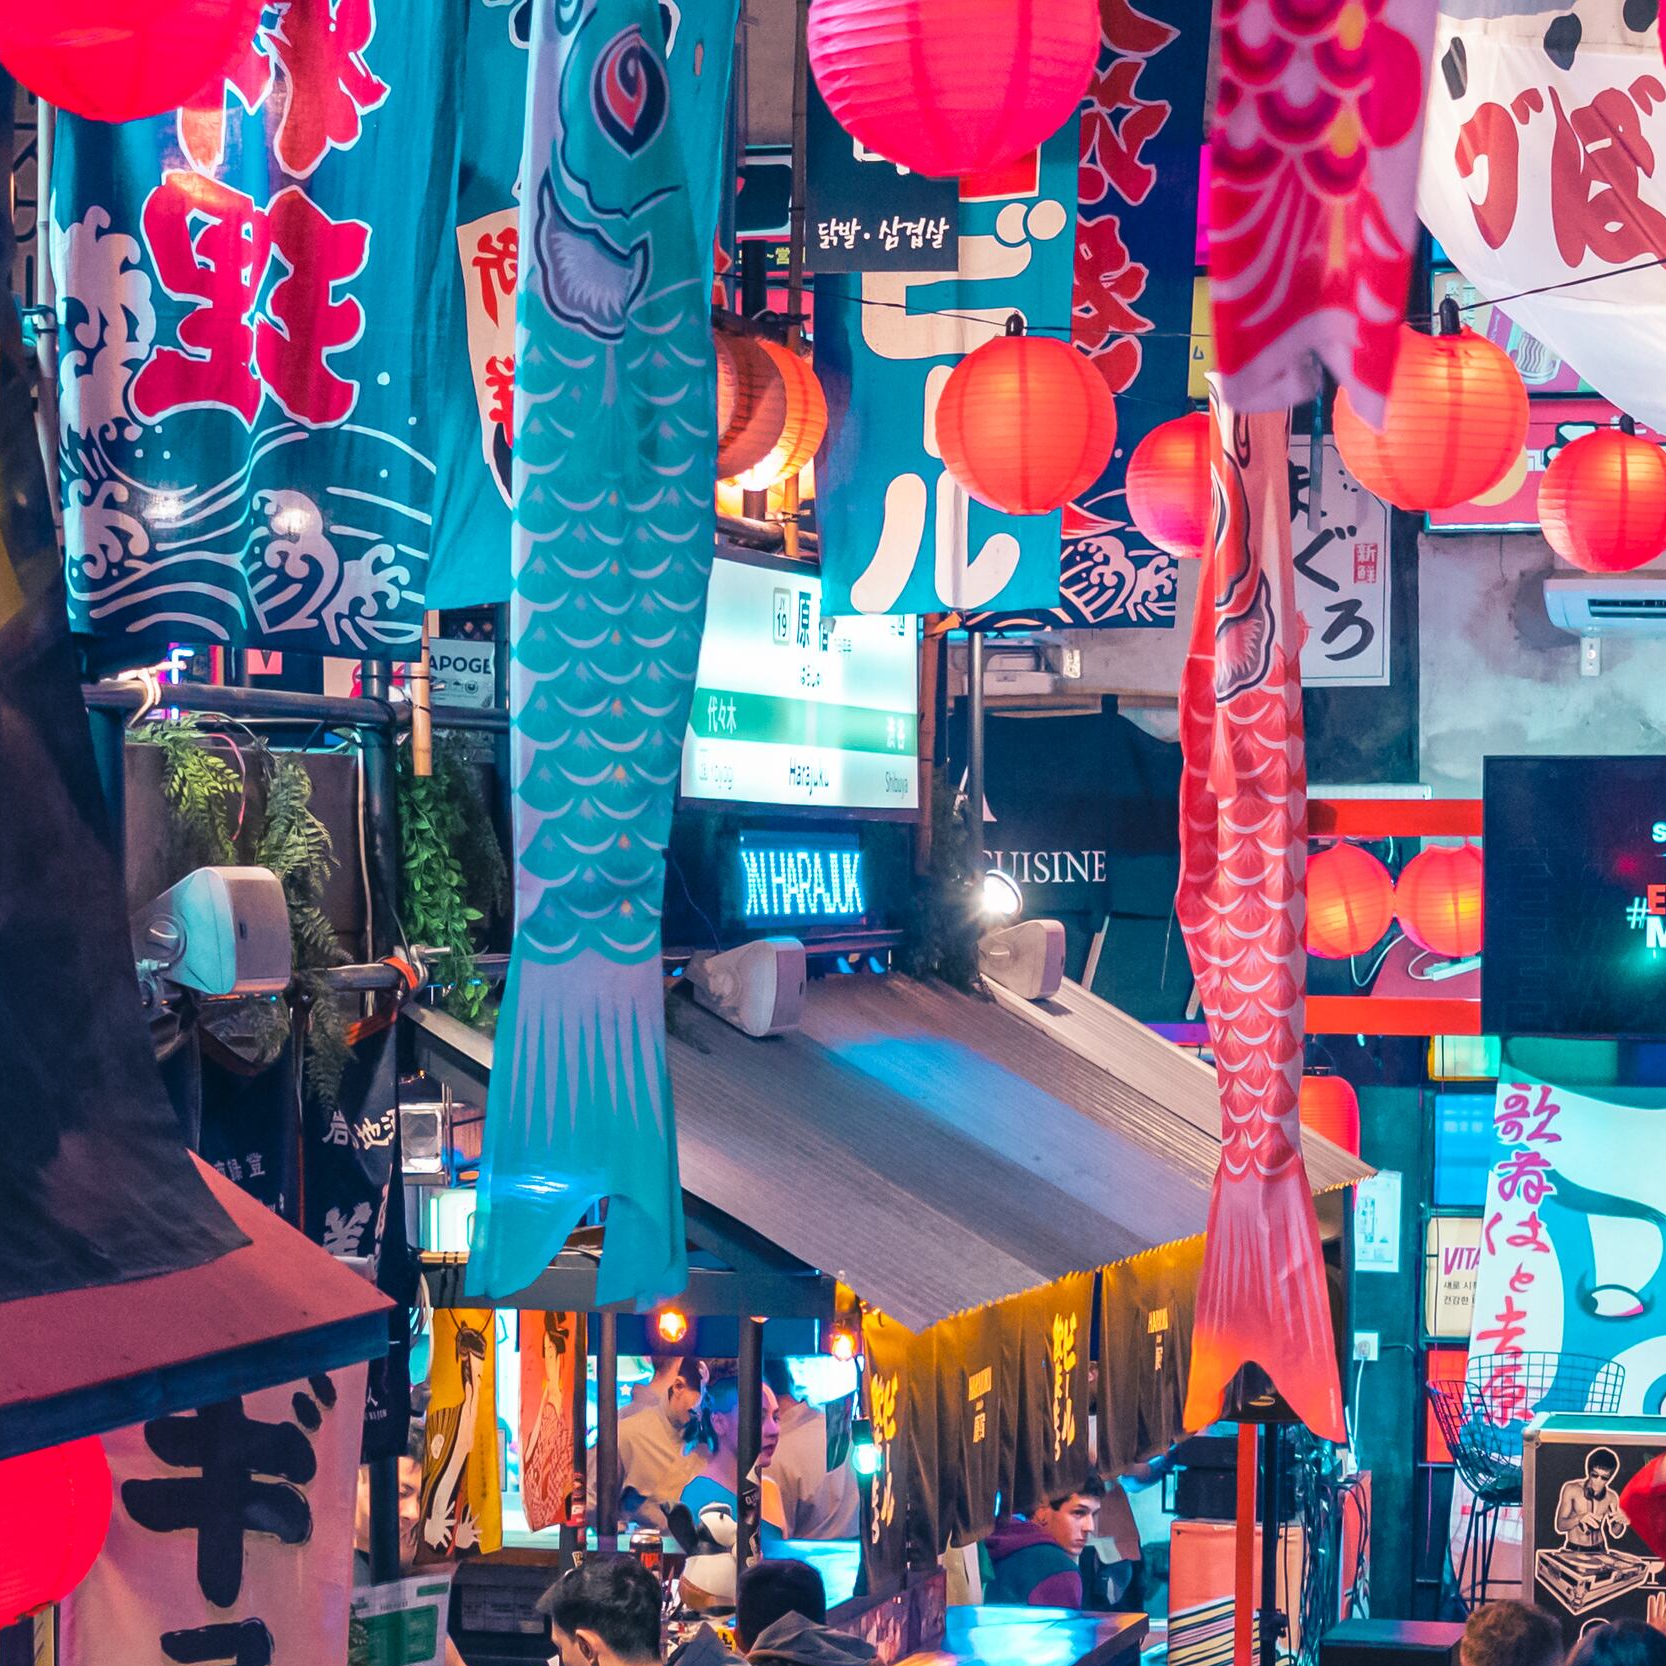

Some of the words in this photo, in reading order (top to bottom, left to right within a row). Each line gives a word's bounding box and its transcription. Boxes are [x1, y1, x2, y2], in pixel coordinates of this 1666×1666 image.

[776, 613, 788, 638] 19
[706, 695, 738, 735] 代々木
[788, 757, 831, 797] Harajuku
